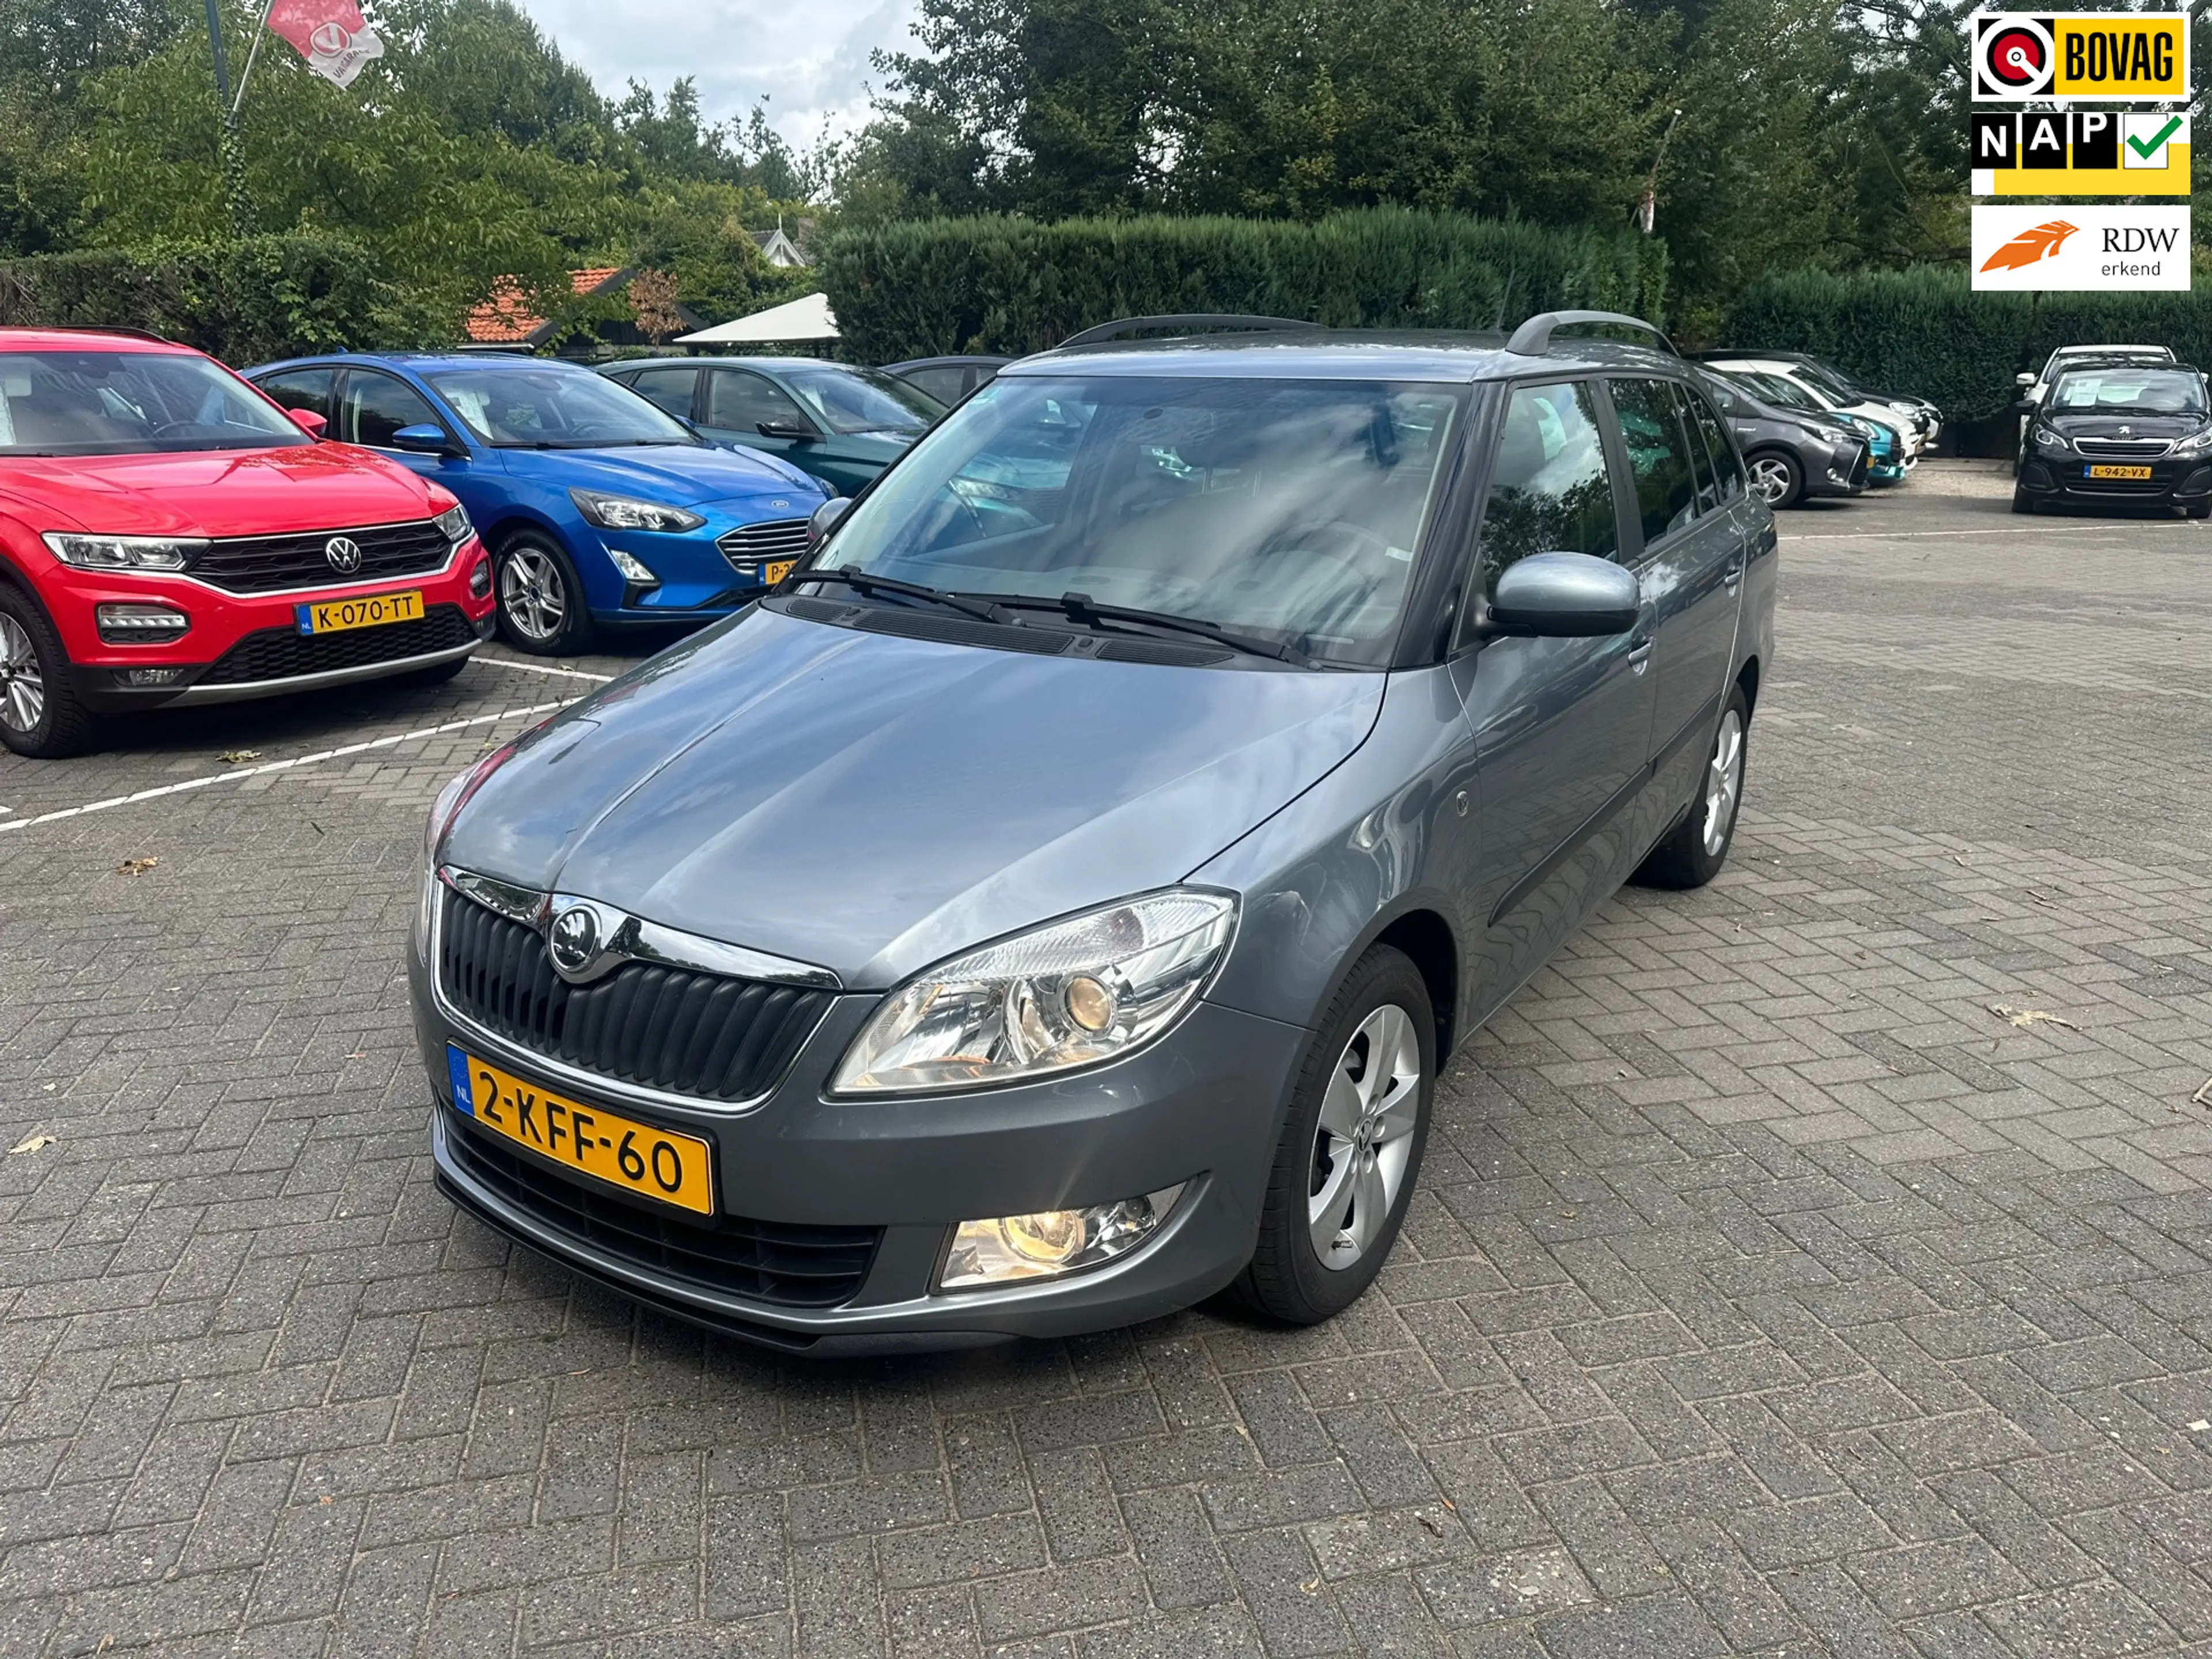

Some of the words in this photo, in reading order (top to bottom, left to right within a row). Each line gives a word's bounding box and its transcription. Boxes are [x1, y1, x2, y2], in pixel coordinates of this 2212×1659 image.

[2093, 467, 2146, 477] L-942-VX
[301, 622, 312, 630] NL
[318, 596, 412, 628] K-070-TT
[456, 1083, 471, 1104] NL
[479, 1070, 683, 1193] 2-KFF-60
